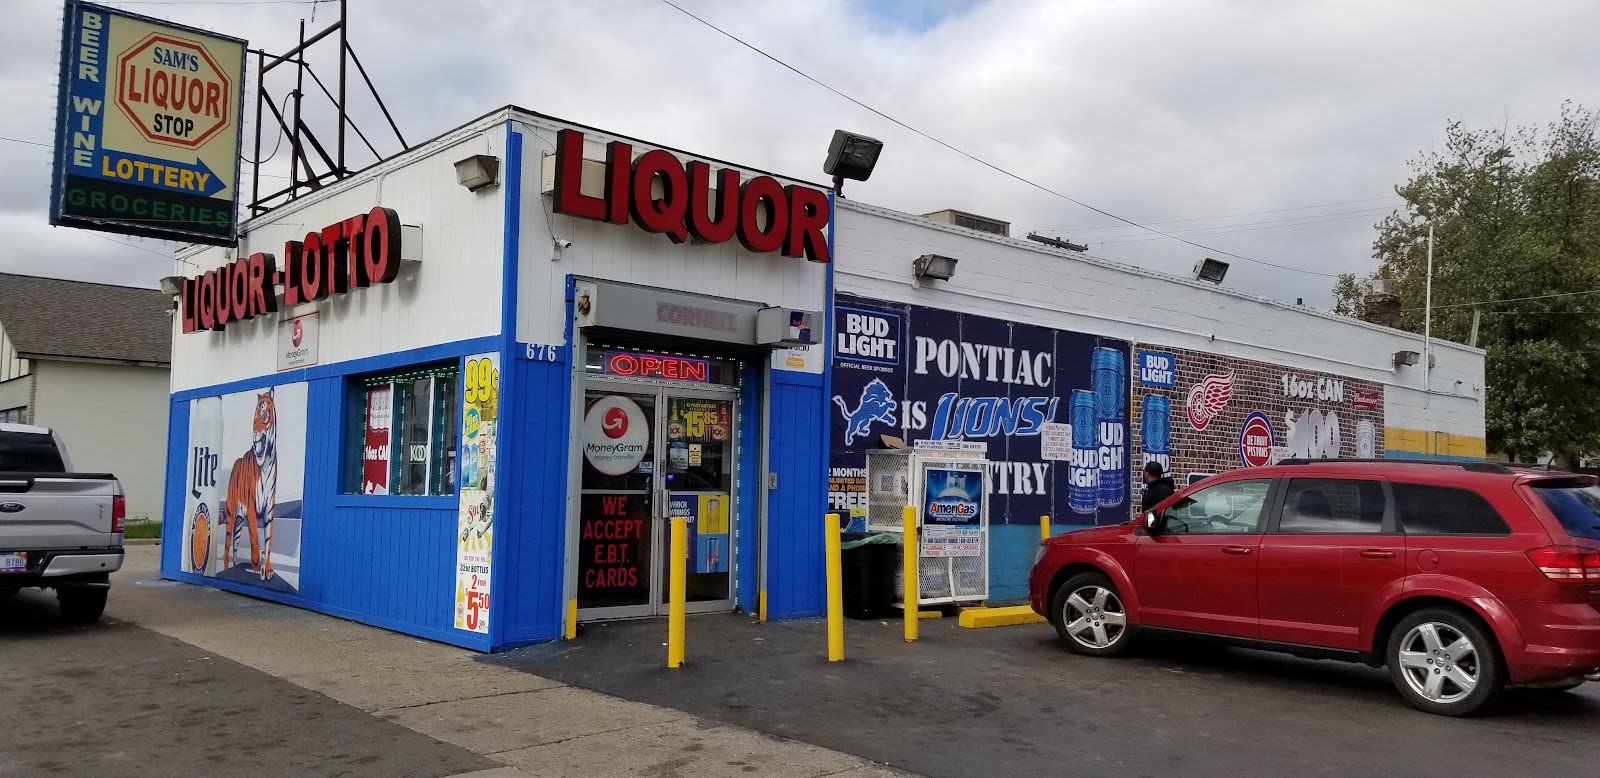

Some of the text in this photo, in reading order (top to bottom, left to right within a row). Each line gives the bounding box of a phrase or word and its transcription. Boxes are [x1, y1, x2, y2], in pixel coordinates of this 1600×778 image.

[153, 46, 199, 72] SAM'S
[73, 11, 102, 168] BEER WINE
[128, 64, 220, 119] LIQUOR
[153, 113, 194, 138] STOP
[102, 156, 211, 192] LOTTERY
[67, 188, 229, 229] GROCERIES
[555, 129, 831, 263] LIQUOR
[846, 313, 889, 338] BUD
[526, 344, 556, 362] 676
[838, 333, 896, 359] LIGHT
[610, 354, 705, 380] OPEN
[914, 336, 1051, 388] PONTIAC
[1145, 354, 1169, 371] BUD
[1141, 367, 1173, 384] LIGHT
[1281, 372, 1344, 403] 16oz CAN
[900, 400, 927, 430] IS
[1098, 421, 1124, 446] UD
[1246, 435, 1268, 446] DETROIT
[586, 443, 643, 454] MoneyGram
[1246, 446, 1268, 458] PISTONS
[191, 446, 218, 500] Lite
[832, 468, 867, 477] MONTHS
[602, 495, 628, 516] WE
[930, 502, 975, 514] AmeriGas
[583, 520, 643, 540] ACCEPT
[594, 544, 630, 564] E.B.T.
[471, 565, 489, 574] BOTTLES
[471, 574, 487, 590] 2 FOR
[585, 567, 638, 588] CARDS
